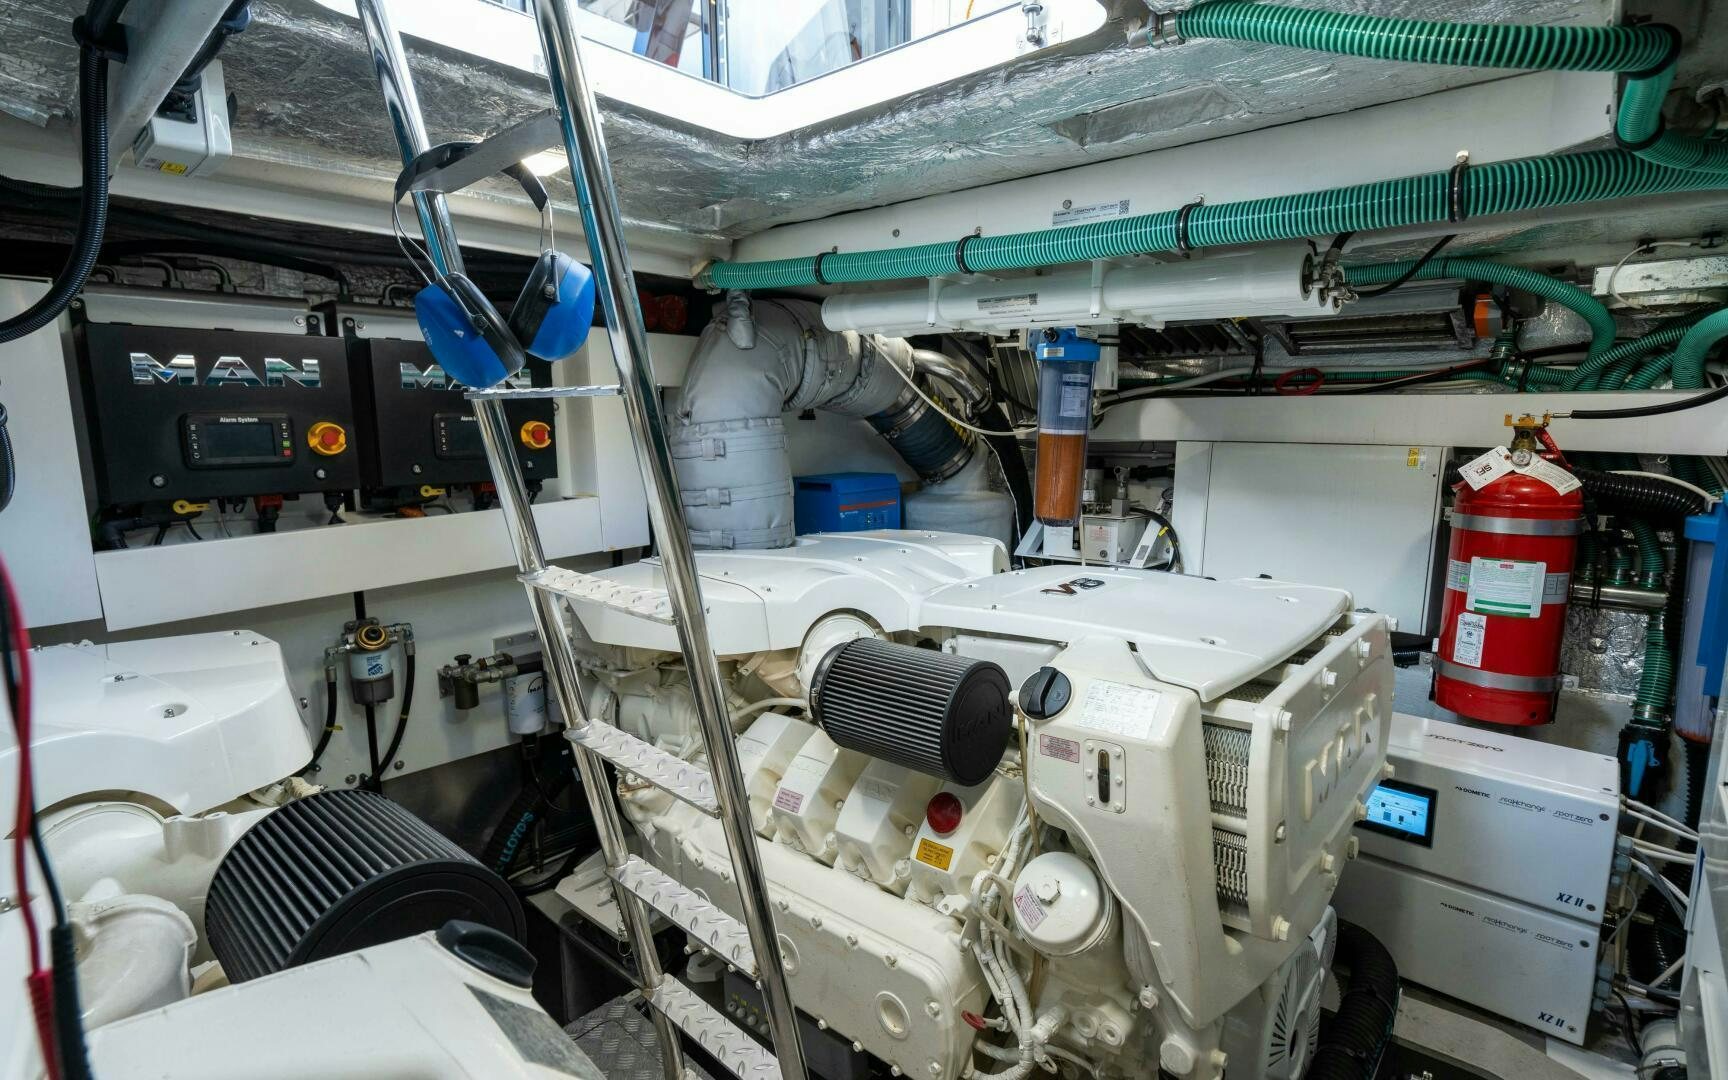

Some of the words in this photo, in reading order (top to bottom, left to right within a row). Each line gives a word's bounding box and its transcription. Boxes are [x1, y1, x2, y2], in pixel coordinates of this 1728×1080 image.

[130, 352, 321, 388] MAN
[400, 362, 532, 391] MN
[237, 416, 259, 424] System
[1463, 787, 1491, 799] DOMETIC
[1556, 892, 1573, 905] XZ
[1574, 897, 1584, 908] II
[1448, 904, 1475, 917] DOMETIC
[1538, 1011, 1554, 1024] XZ
[1555, 1017, 1565, 1028] II
